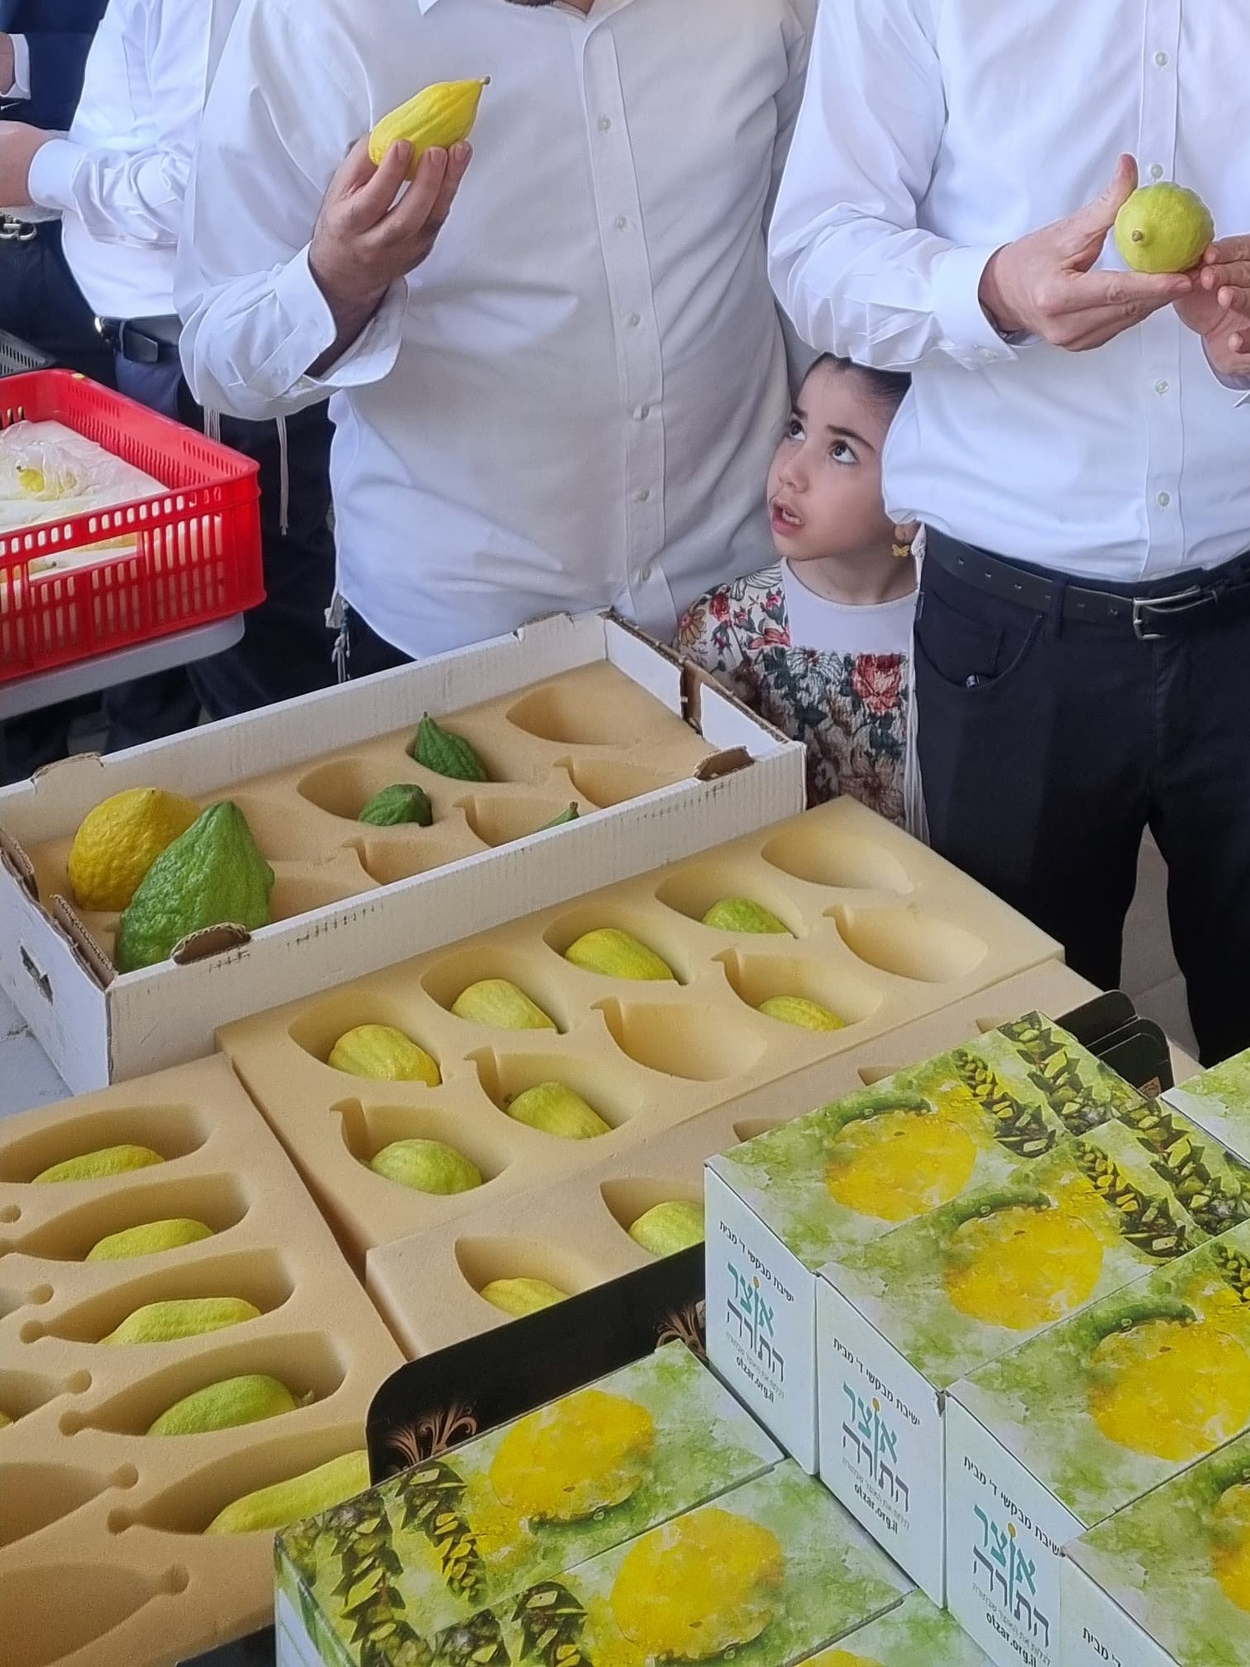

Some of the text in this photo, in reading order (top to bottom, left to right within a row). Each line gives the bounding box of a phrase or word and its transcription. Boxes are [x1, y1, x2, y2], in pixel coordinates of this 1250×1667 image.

[719, 1220, 738, 1246] מבית
[748, 1248, 772, 1281] מבקשי
[727, 1261, 775, 1338] אוצר
[773, 1275, 795, 1303] ישיבת
[726, 1297, 785, 1383] התורה
[833, 1337, 854, 1365] מבית
[736, 1356, 774, 1403] otzar.org.il
[866, 1370, 894, 1403] מבקשי
[843, 1380, 897, 1464] אוצר
[896, 1398, 920, 1426] ישיבת
[842, 1421, 909, 1512] התורה
[964, 1455, 987, 1485] מבית
[854, 1482, 898, 1534] otzar.org.il
[1001, 1491, 1032, 1529] מבקשי
[974, 1504, 1036, 1596] אוצר
[1035, 1525, 1060, 1556] שיבת
[973, 1544, 1050, 1648] התורה
[986, 1611, 1037, 1667] otzar.org.il
[1082, 1627, 1109, 1661] מבית
